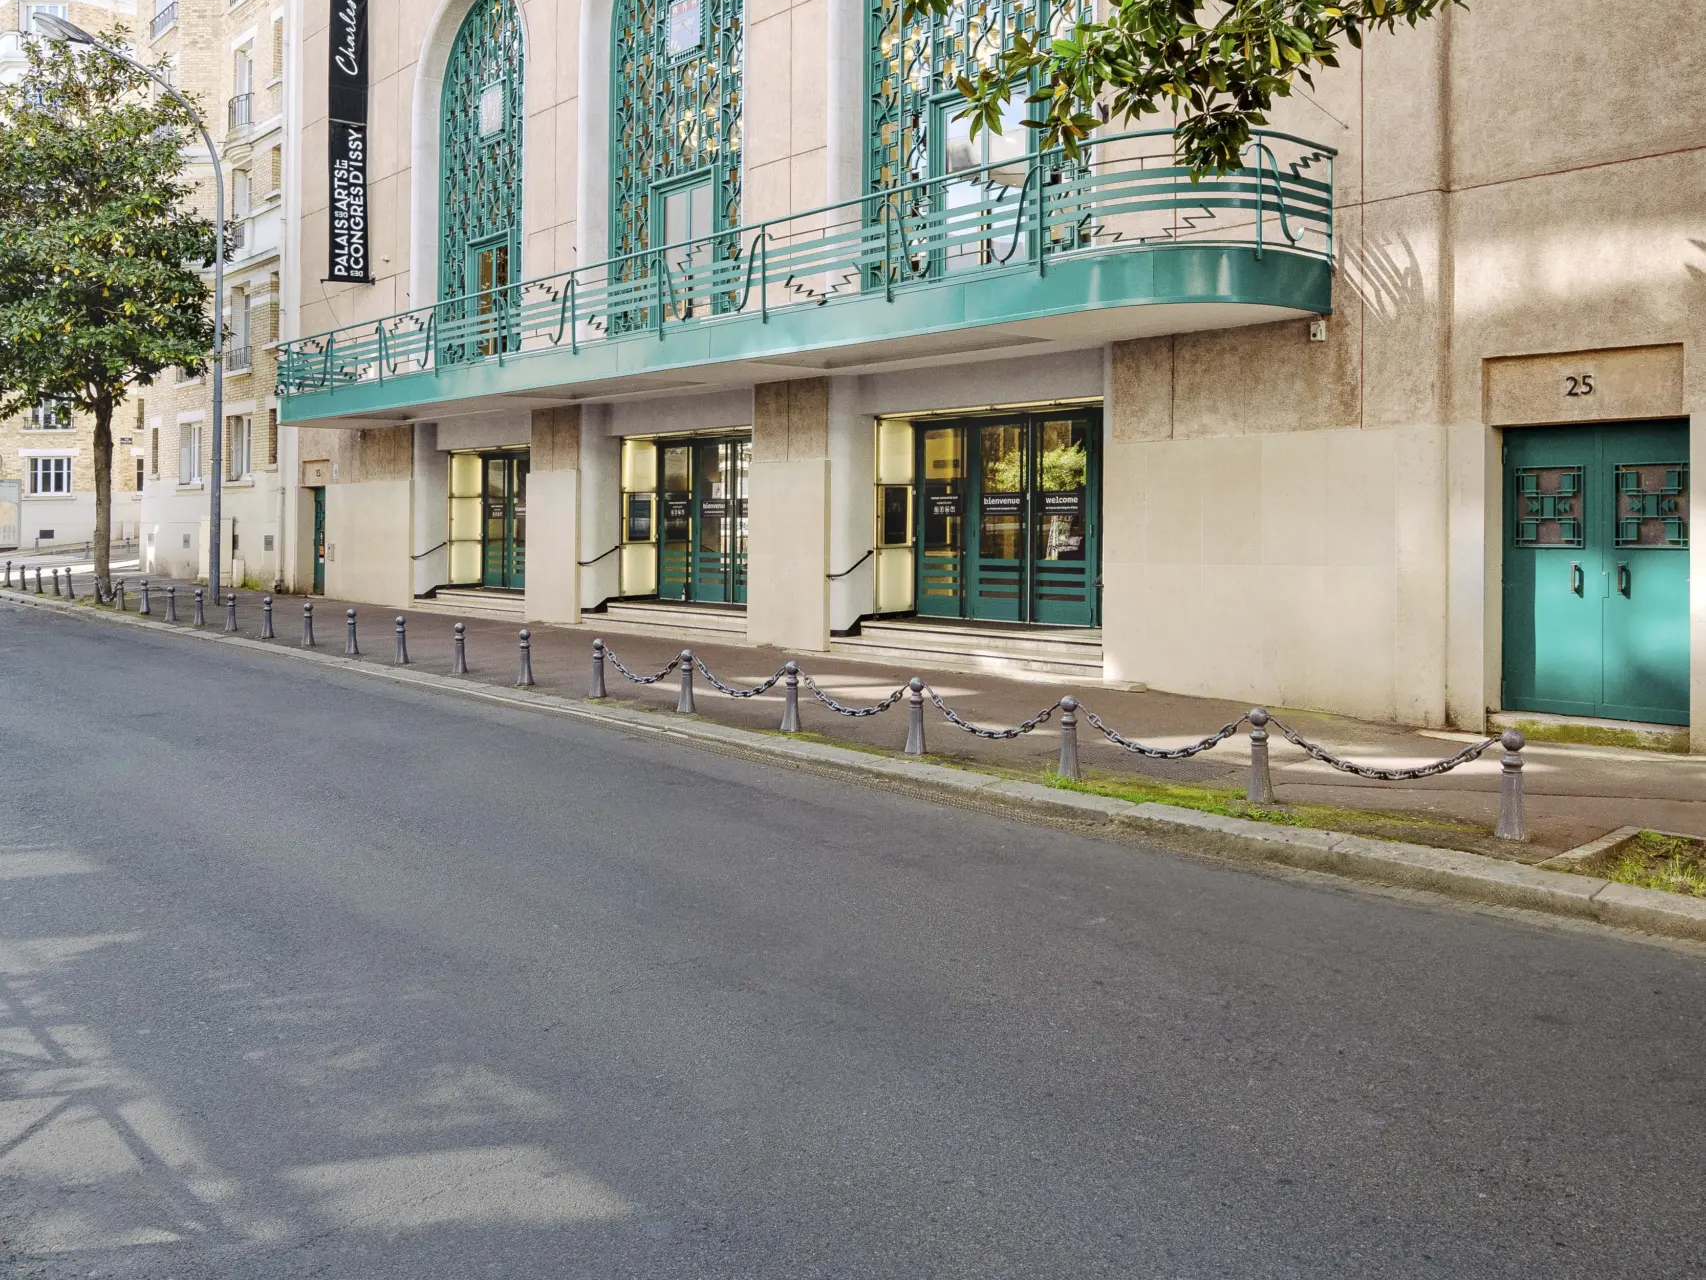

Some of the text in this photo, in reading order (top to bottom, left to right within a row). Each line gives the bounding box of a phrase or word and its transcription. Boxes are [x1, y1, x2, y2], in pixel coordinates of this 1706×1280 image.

[348, 128, 364, 184] D'ISSY
[334, 159, 349, 276] PALAIS DES ARTS ET
[350, 269, 364, 277] DES
[1565, 374, 1593, 396] 25
[983, 497, 1020, 505] bienvenue
[1045, 496, 1078, 504] welcome
